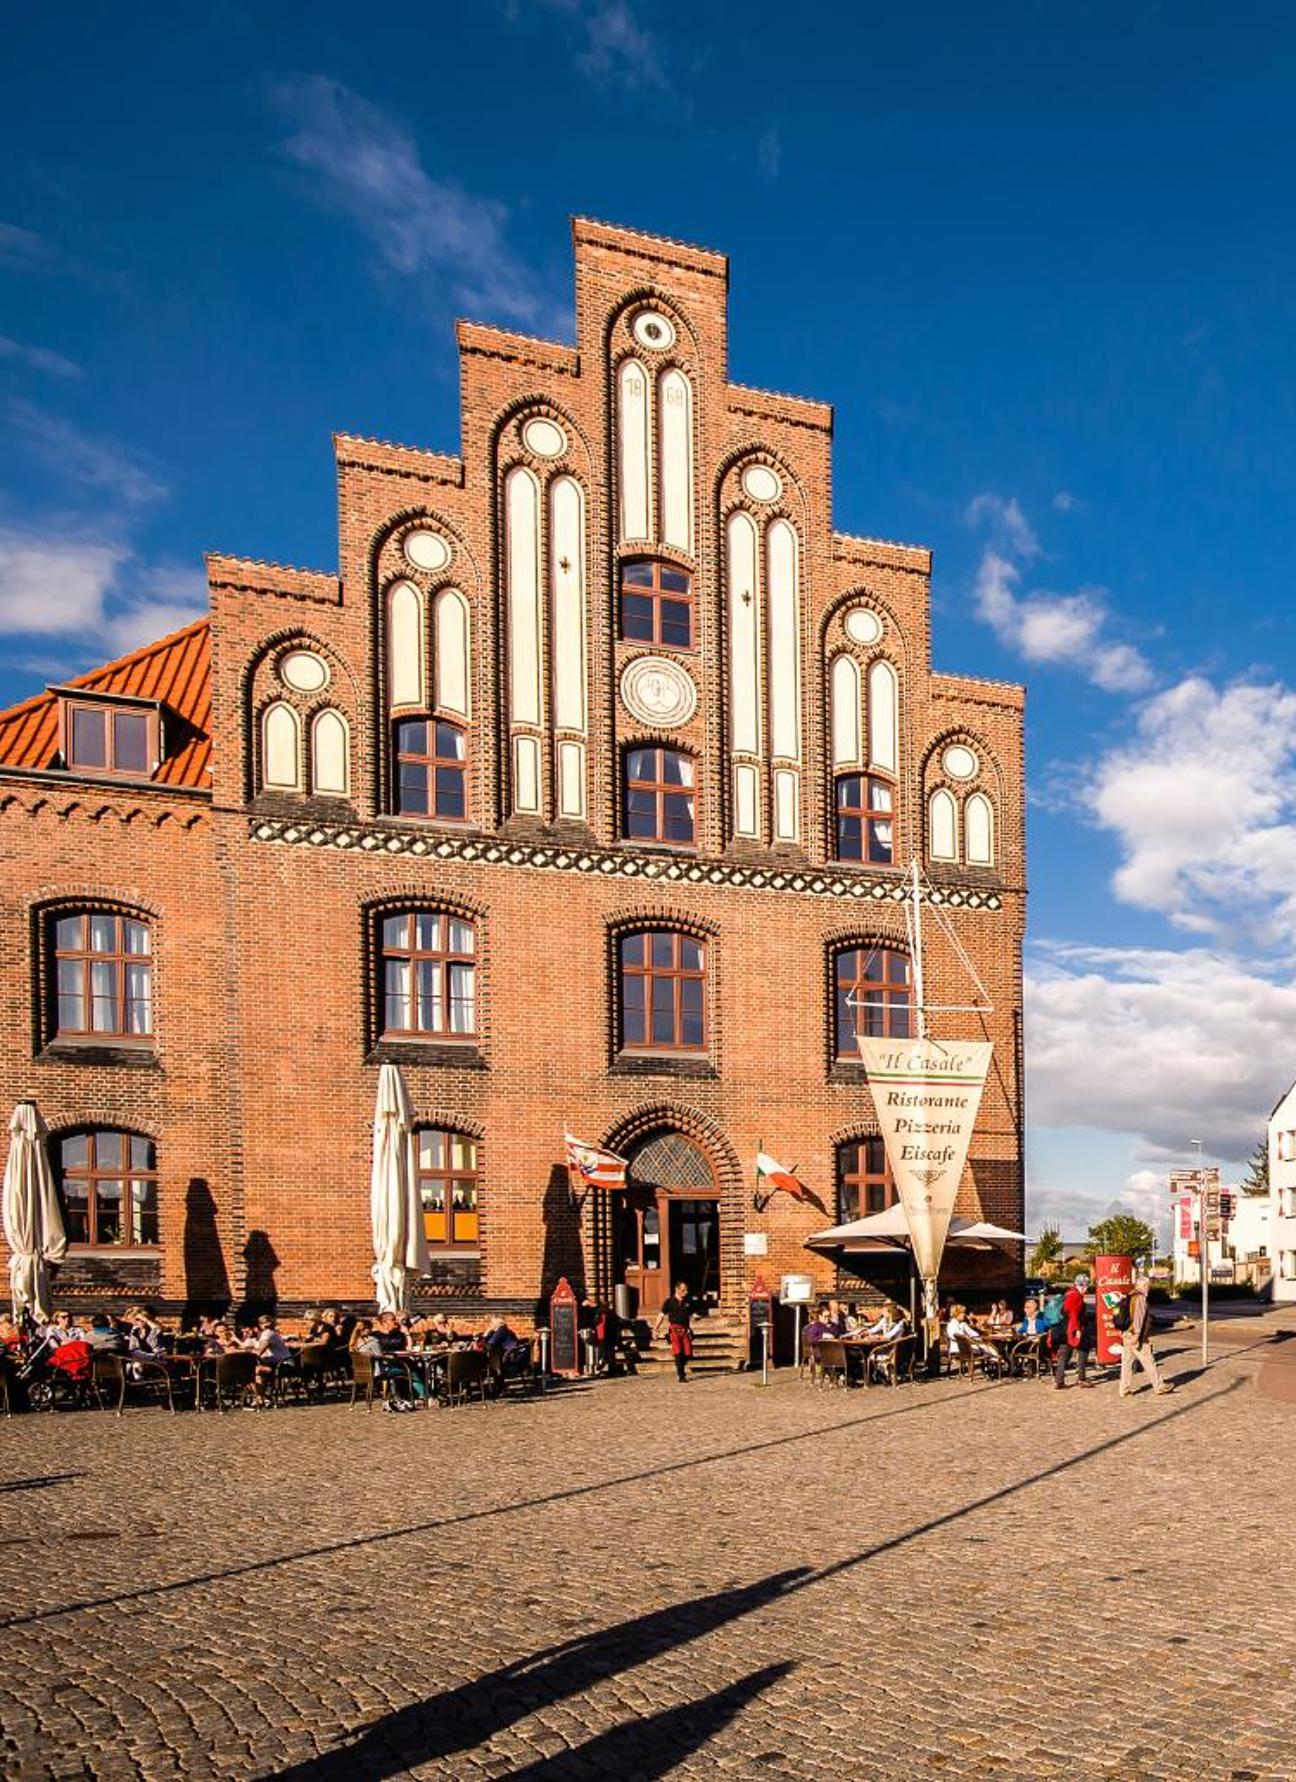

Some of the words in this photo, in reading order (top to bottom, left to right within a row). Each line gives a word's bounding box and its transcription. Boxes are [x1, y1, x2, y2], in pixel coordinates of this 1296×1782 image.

[887, 1091, 969, 1108] Ristorante
[894, 1118, 961, 1135] Pizzeria
[900, 1145, 955, 1165] Eiscafe
